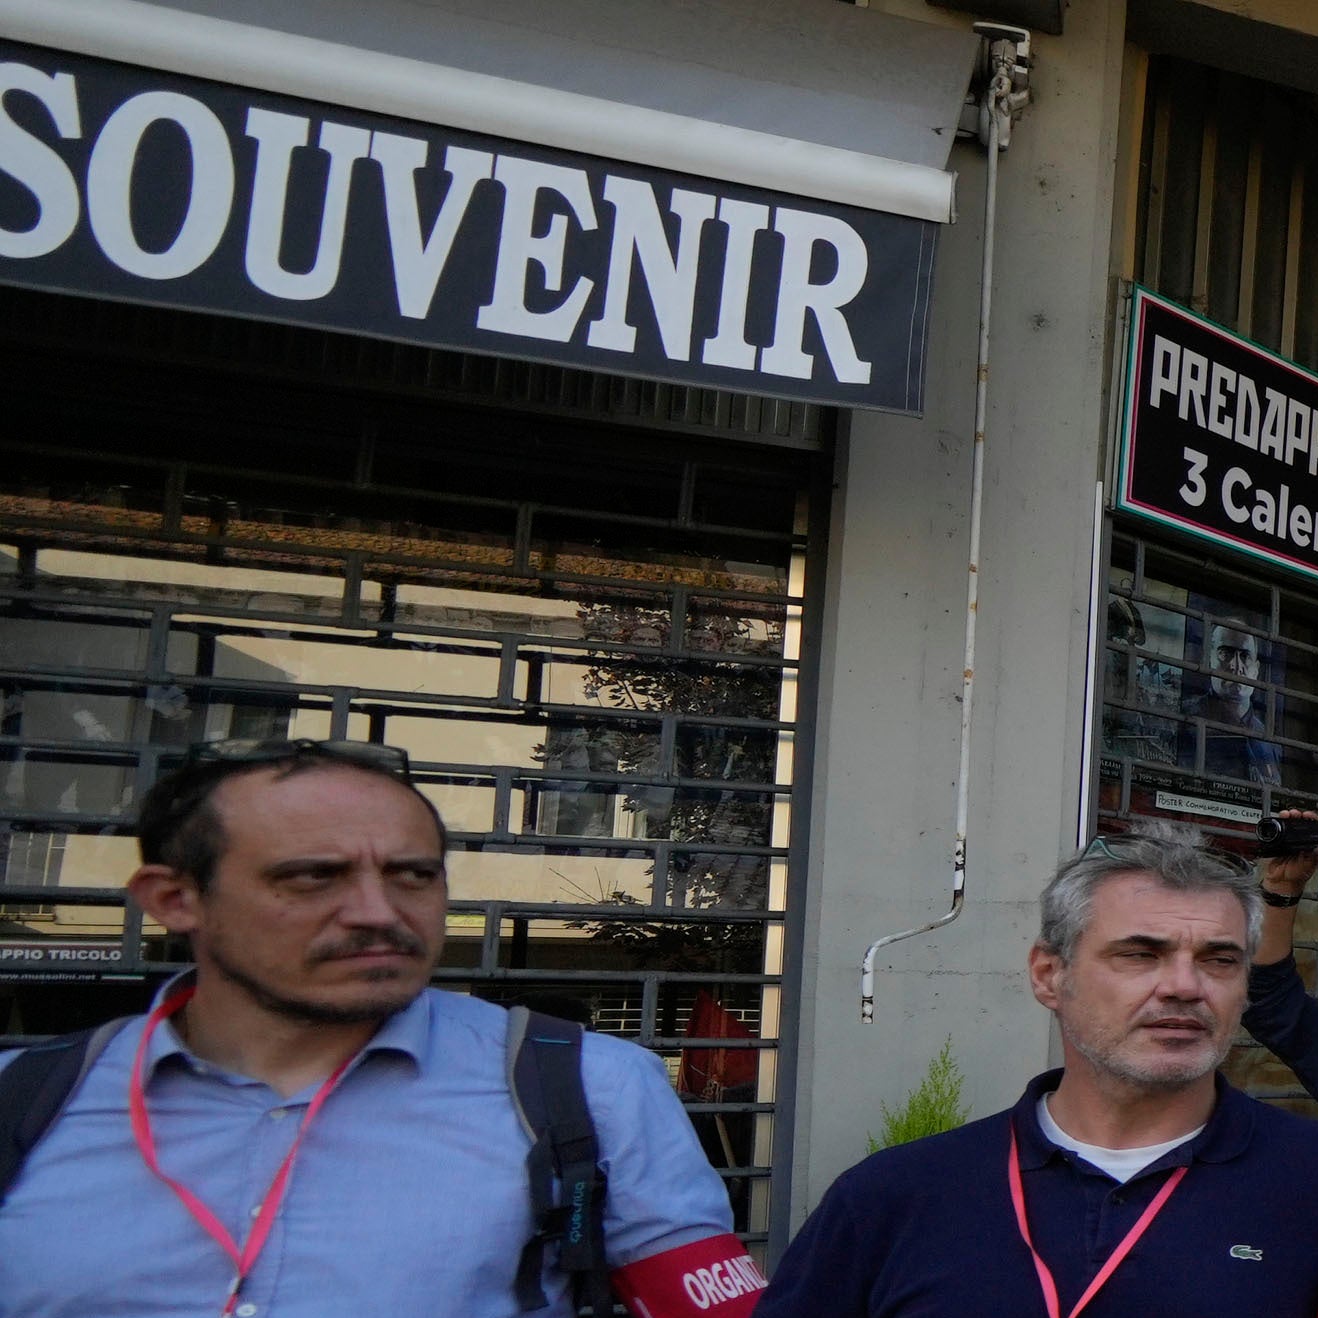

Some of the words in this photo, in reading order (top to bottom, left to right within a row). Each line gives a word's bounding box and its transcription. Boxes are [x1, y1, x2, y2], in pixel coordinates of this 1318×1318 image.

[0, 61, 871, 385] SOUVENIR
[1179, 447, 1207, 507] 3
[1158, 794, 1184, 808] POSTER
